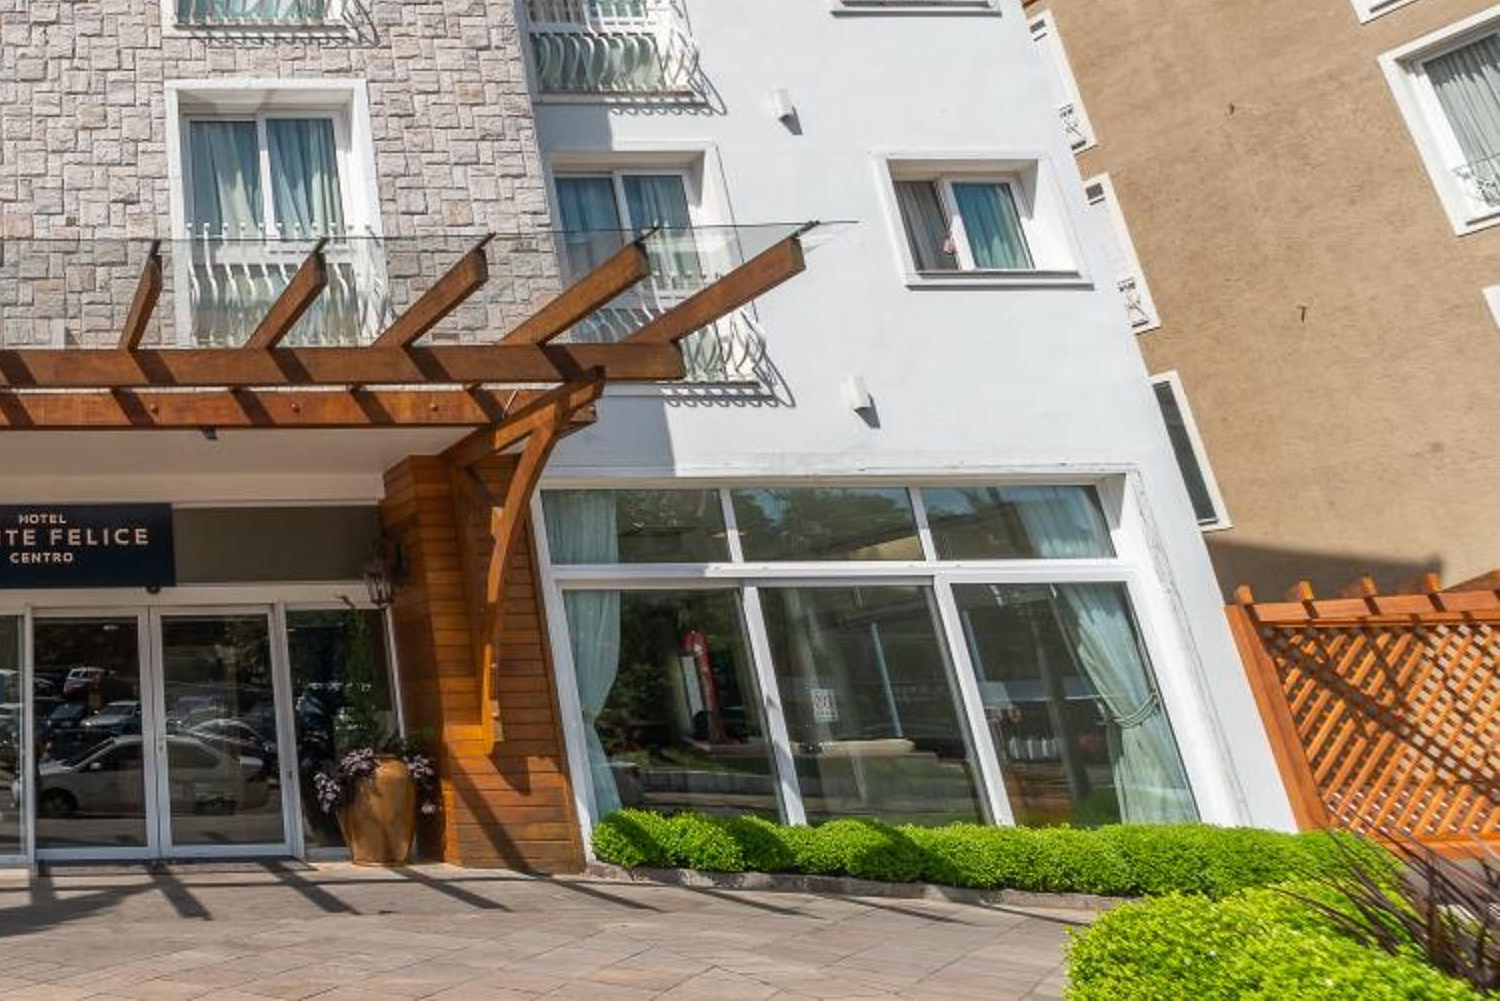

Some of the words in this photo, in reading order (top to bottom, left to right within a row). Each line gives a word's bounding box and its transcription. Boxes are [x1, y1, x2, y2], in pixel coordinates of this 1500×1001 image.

[18, 513, 67, 525] HOTEL
[50, 528, 149, 546] FELICE
[9, 552, 74, 564] CENTRO
